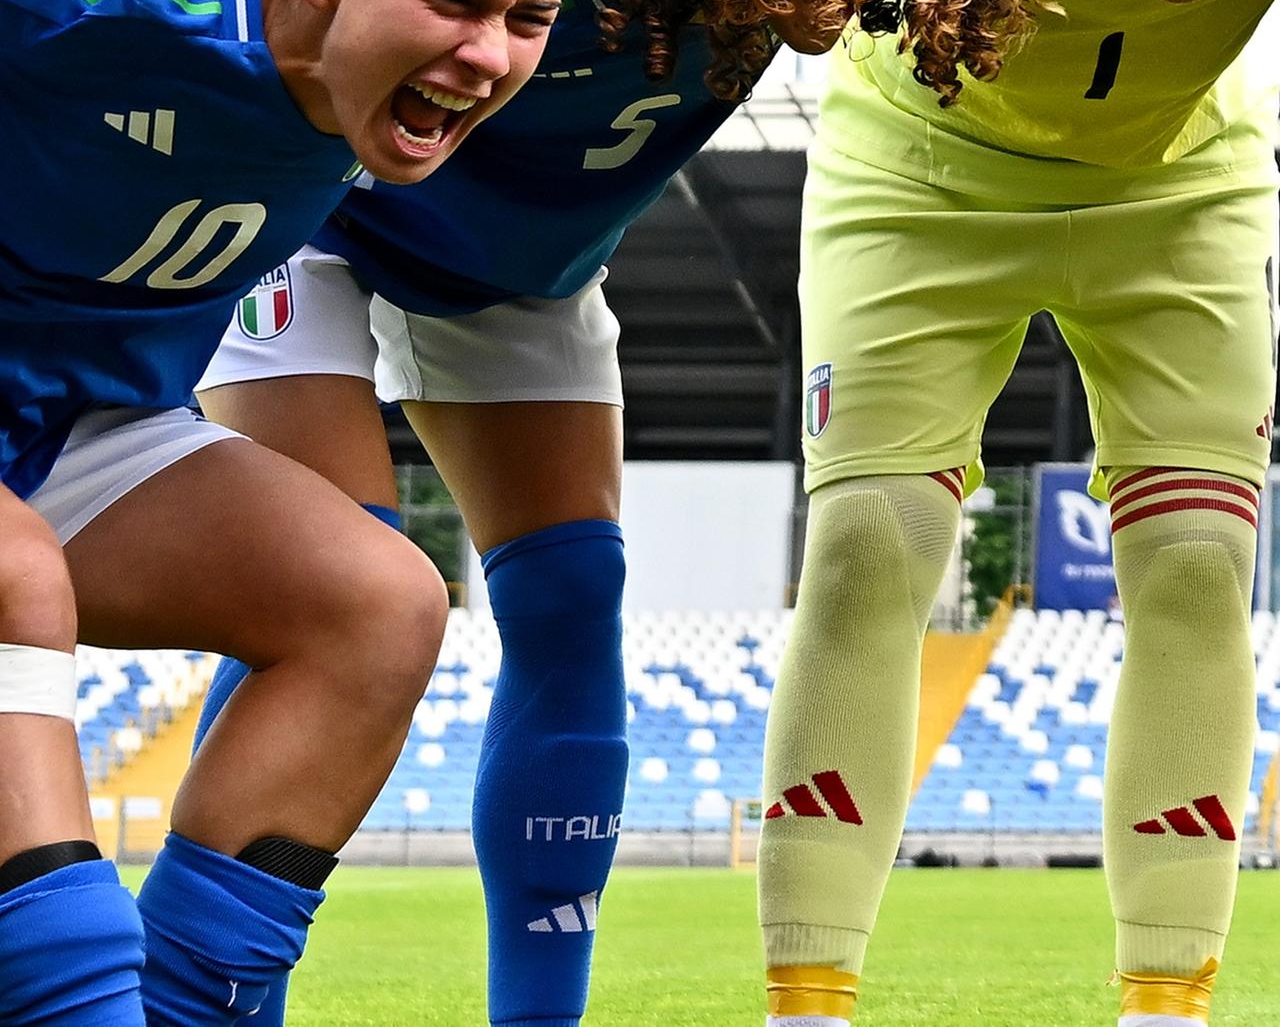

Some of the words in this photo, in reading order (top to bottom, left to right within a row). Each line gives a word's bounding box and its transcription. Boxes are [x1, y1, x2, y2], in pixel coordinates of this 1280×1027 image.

[1084, 31, 1125, 100] 1
[583, 94, 681, 170] 5
[100, 199, 267, 290] 10
